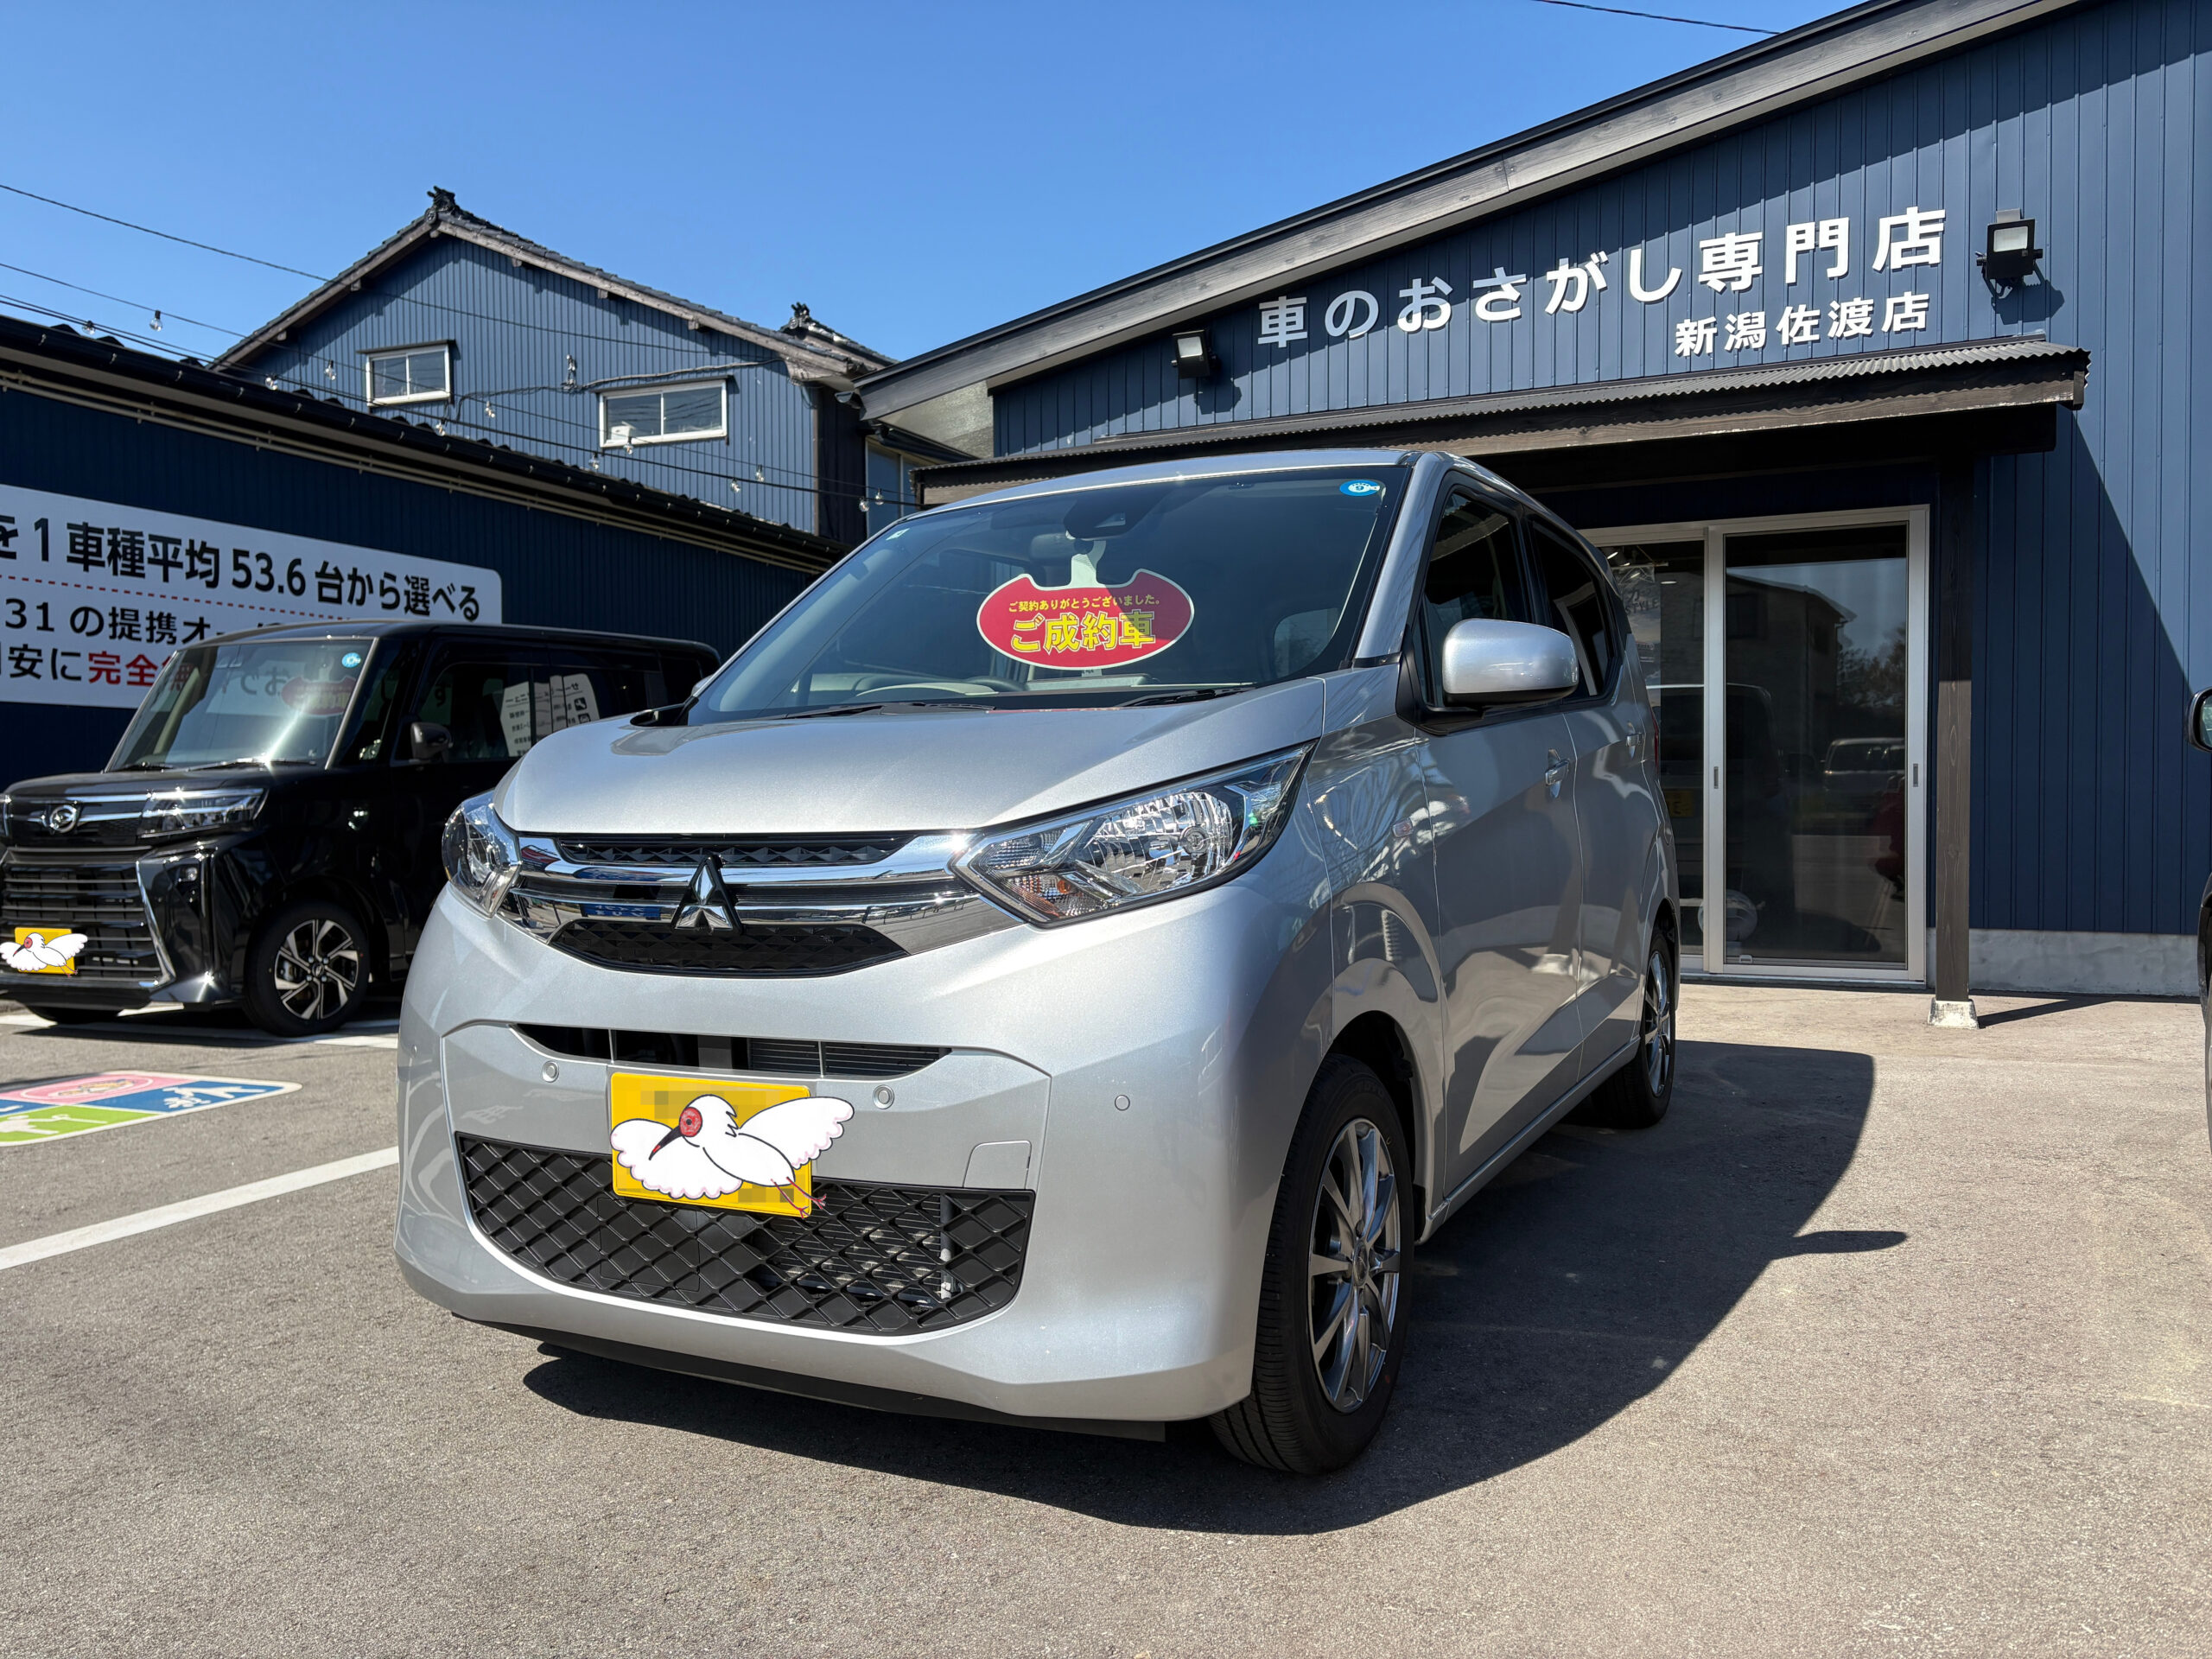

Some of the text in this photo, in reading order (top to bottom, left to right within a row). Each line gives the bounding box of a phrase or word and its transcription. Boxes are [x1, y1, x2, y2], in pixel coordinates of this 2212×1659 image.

[1258, 207, 1946, 348] 車のおさがし専門店
[1675, 291, 1929, 357] 新潟佐渡店
[1010, 608, 1156, 655] ご成約車
